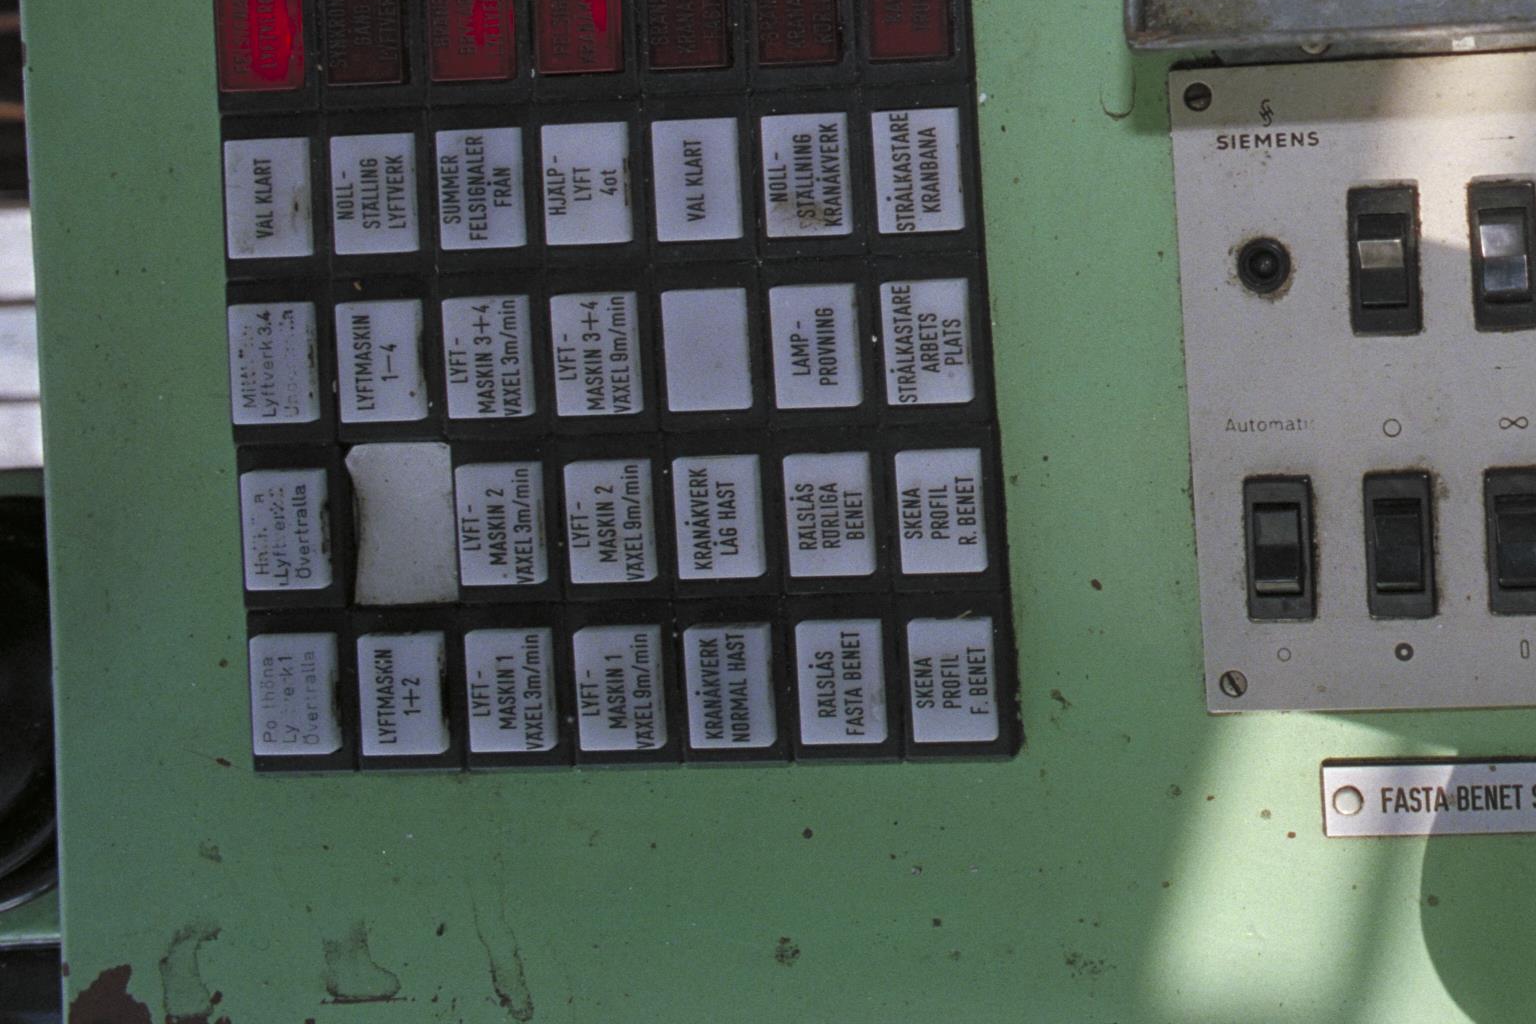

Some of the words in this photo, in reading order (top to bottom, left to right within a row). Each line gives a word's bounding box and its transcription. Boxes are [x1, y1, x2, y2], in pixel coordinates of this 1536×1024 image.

[682, 139, 704, 186] KLART
[1215, 131, 1321, 151] SIEMENS
[253, 157, 273, 204] KLART
[385, 153, 407, 228] LYFTVERK
[440, 154, 462, 224] SUMMER
[464, 135, 488, 240] FELSIGNALER
[572, 166, 593, 201] LYFT
[917, 126, 942, 213] KRANBANA
[255, 209, 274, 238] VAL
[685, 192, 706, 221] VAL
[497, 298, 520, 365] 3m/min
[606, 295, 629, 361] 9m/min
[814, 306, 838, 385] PROVNING
[917, 312, 941, 372] ARBETS
[941, 318, 964, 365] PLATS
[351, 313, 375, 410] LYFTMASKIN
[474, 351, 497, 413] MASKIN
[583, 347, 605, 410] MASKIN
[485, 487, 505, 497] 2
[511, 467, 533, 533] 3m/min
[593, 484, 614, 494] 2
[620, 463, 643, 529] 9m/min
[715, 480, 737, 519] HAST
[843, 490, 866, 539] BENET
[901, 486, 924, 539] SKENA
[928, 483, 951, 539] PROFIL
[954, 475, 977, 525] BENET
[486, 503, 508, 565] MASKIN
[595, 500, 618, 562] MASKIN
[958, 530, 978, 545] R.
[495, 654, 514, 662] 1
[521, 633, 542, 699] 3m/min
[631, 632, 653, 698] 9m/min
[725, 632, 746, 671] HAST
[840, 630, 862, 680] BENET
[966, 646, 989, 695] BENET
[373, 648, 398, 743] LYFTMASKIN
[496, 667, 517, 729] MASKIN
[605, 666, 628, 728] MASKIN
[913, 656, 936, 708] SKENA
[940, 653, 962, 708] PROFIL
[969, 700, 990, 714] F.
[728, 677, 751, 742] NORMAL
[843, 686, 865, 735] FASTA
[1380, 785, 1449, 814] FASTA
[1456, 784, 1523, 813] BENET
